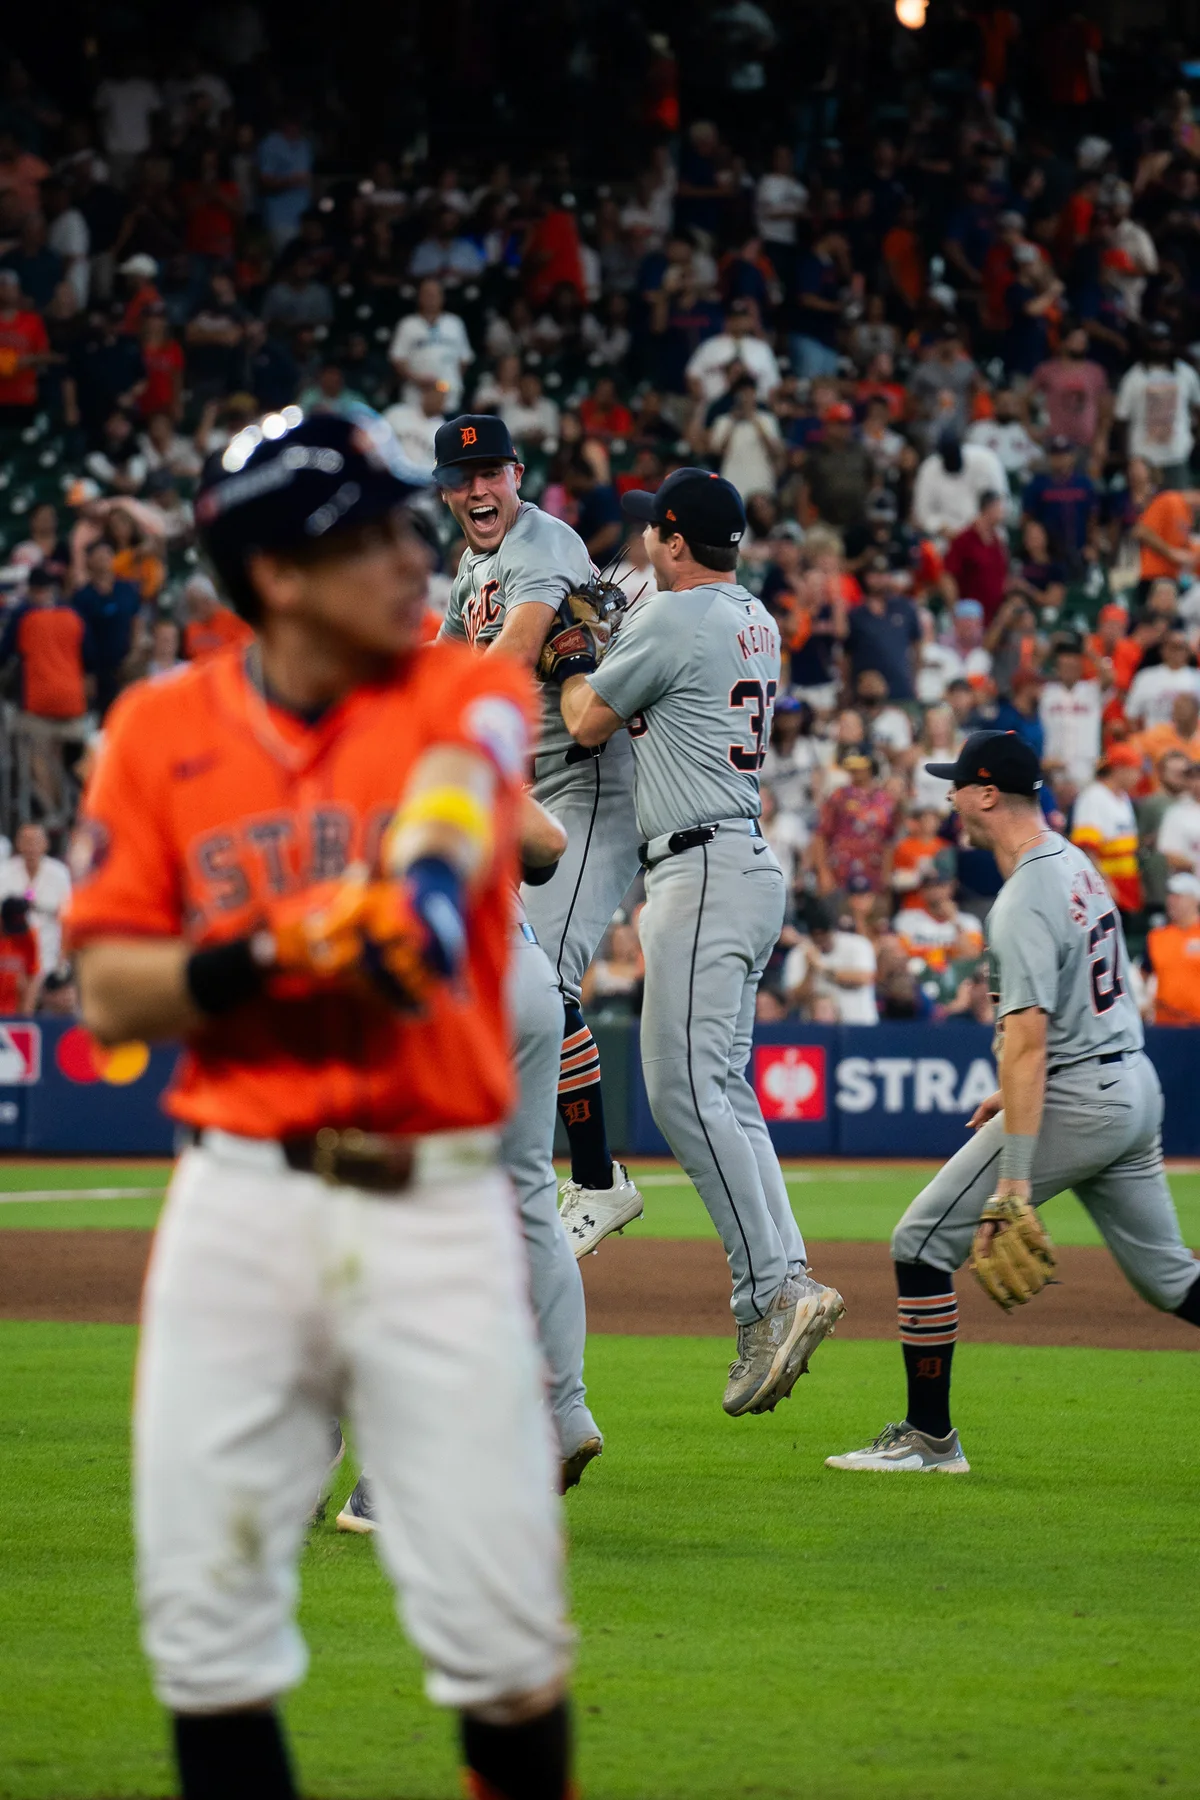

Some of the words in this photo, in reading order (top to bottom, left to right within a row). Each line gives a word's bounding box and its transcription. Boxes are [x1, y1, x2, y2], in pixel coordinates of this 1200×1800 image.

[460, 426, 477, 448] D
[736, 624, 776, 661] KEITH
[560, 1098, 591, 1126] D
